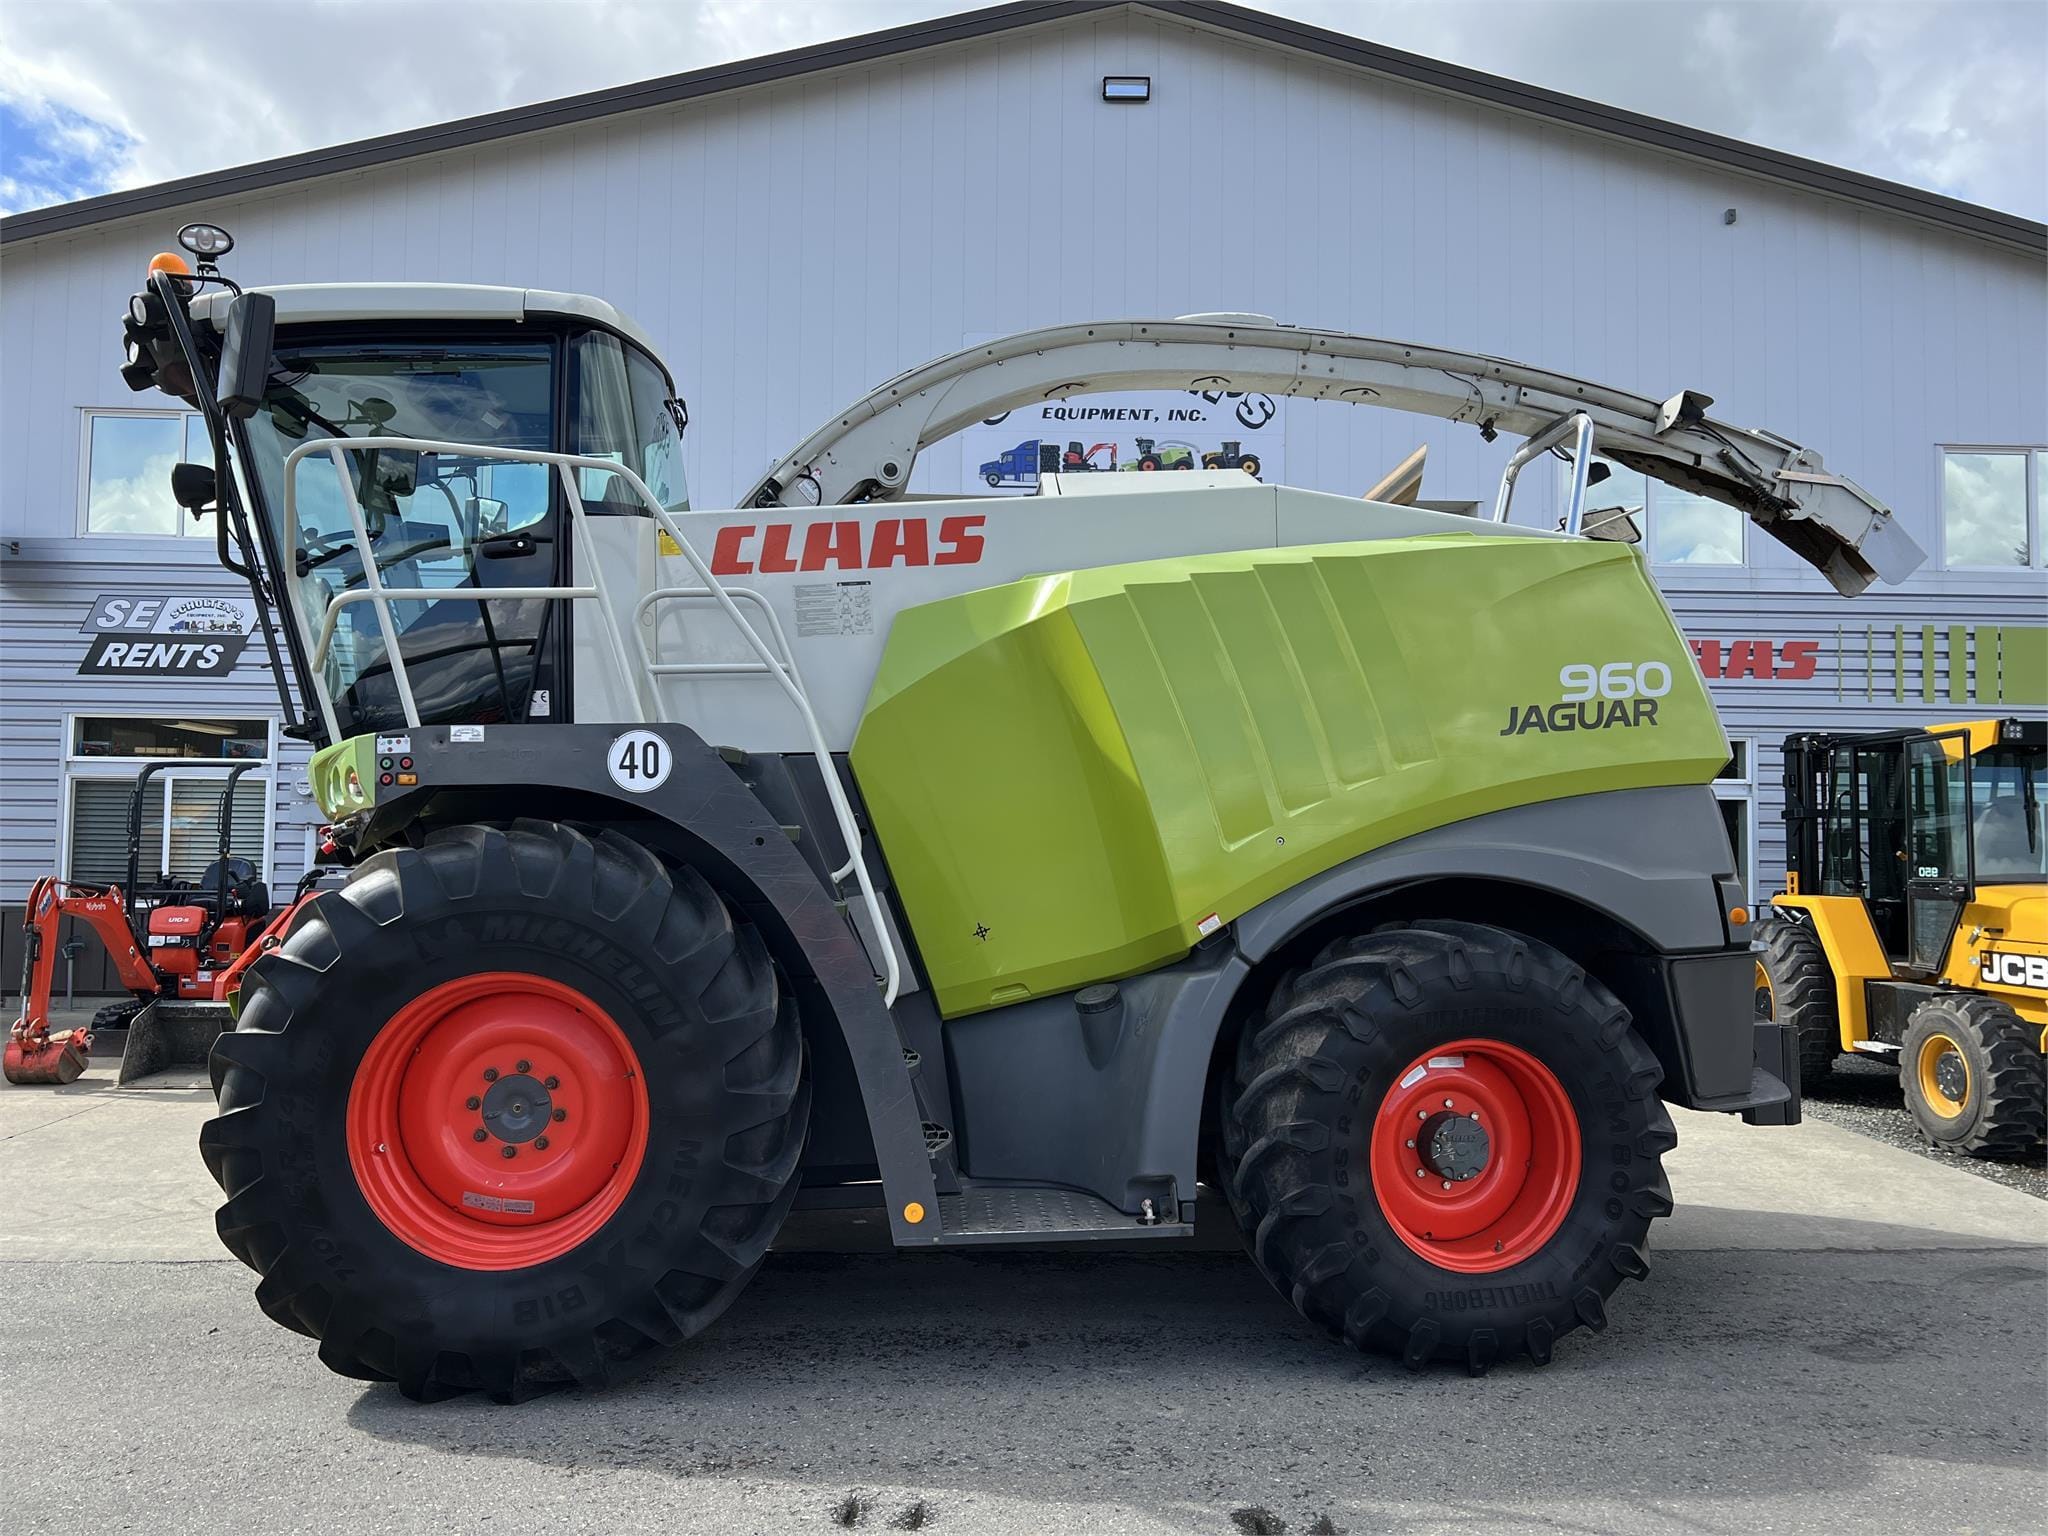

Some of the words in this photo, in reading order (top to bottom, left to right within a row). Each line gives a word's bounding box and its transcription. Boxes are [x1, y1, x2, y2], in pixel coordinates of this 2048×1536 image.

[1042, 407, 1160, 423] EQUIPMENT,
[1168, 409, 1207, 422] INC.
[710, 515, 986, 576] CLAAS
[96, 600, 162, 628] SE
[96, 642, 225, 669] RENTS
[1688, 640, 1819, 679] AAS
[1559, 661, 1672, 702] 960
[1500, 699, 1658, 736] JAGUAR
[619, 740, 660, 779] 40
[483, 914, 681, 1026] MICHELIN
[1981, 952, 2048, 988] JCB
[1424, 1281, 1561, 1312] TRELLEBORG
